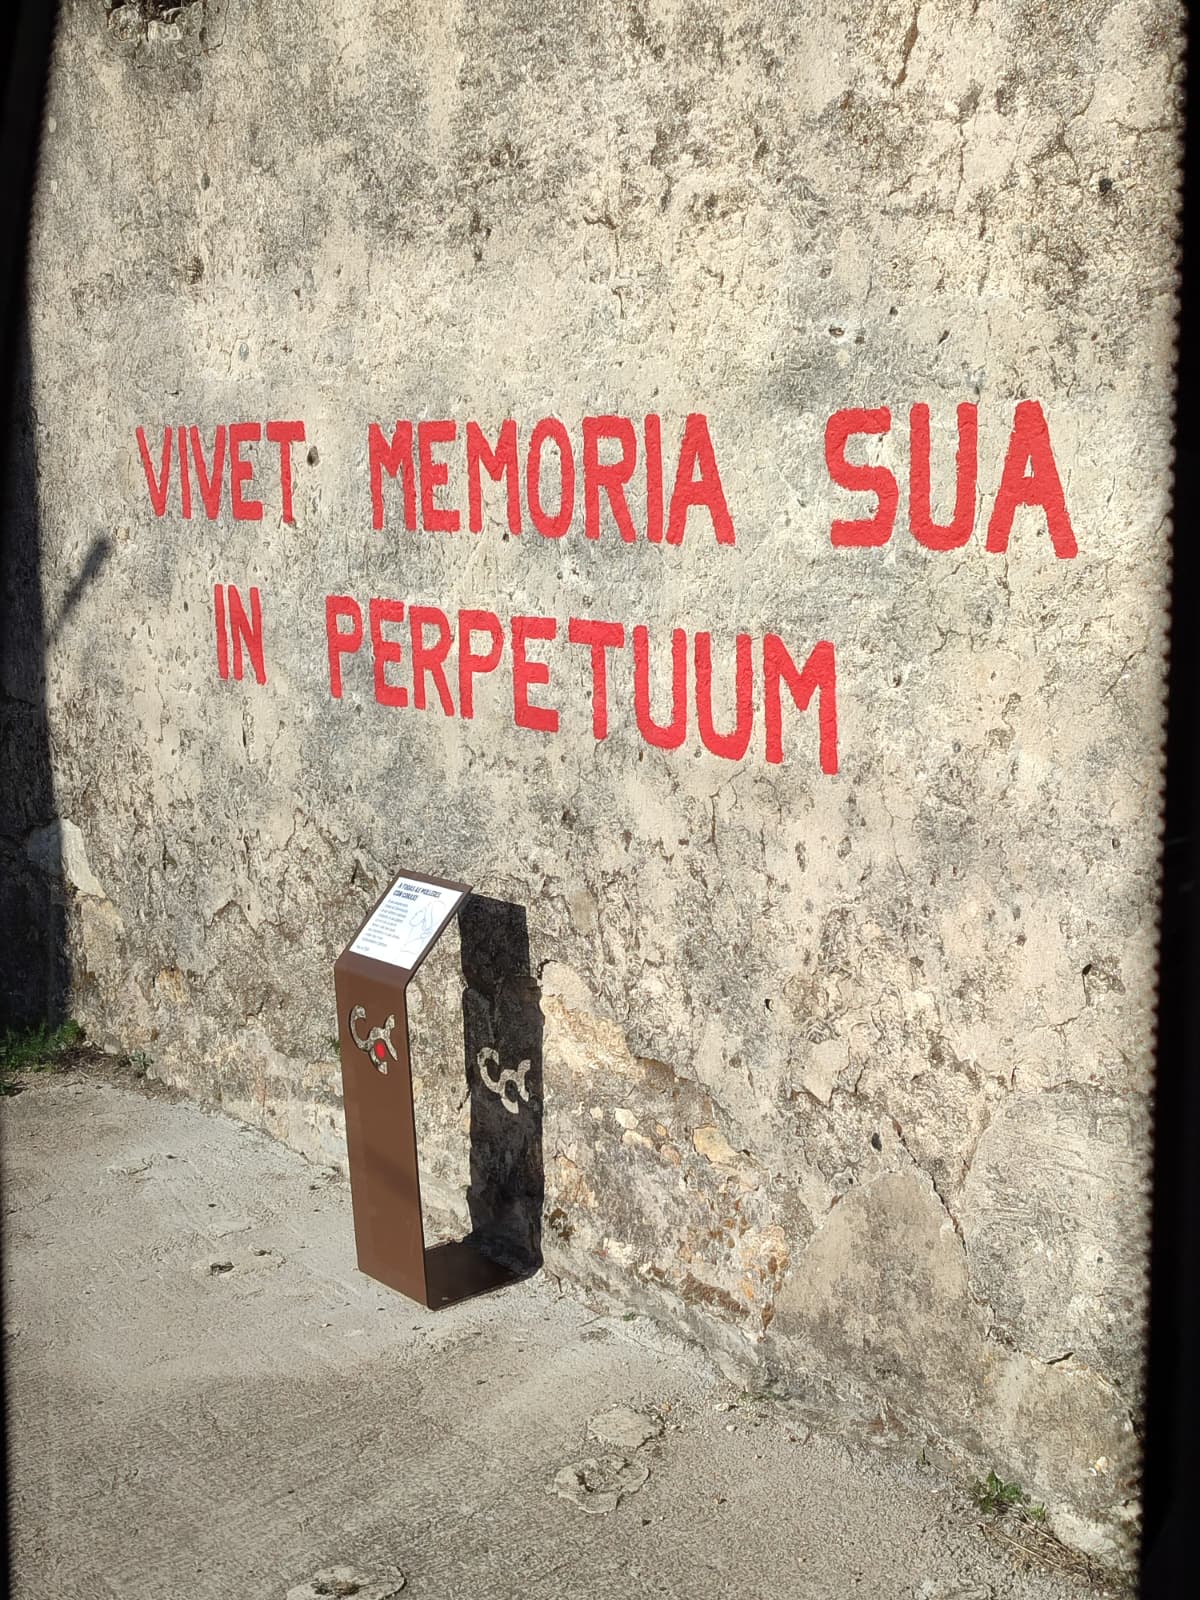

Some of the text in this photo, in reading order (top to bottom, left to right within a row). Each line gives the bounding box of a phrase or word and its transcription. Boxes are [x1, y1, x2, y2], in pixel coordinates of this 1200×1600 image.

[136, 400, 1079, 560] VIVET MEMORIA SUA
[214, 583, 839, 776] IN PERPETUUM
